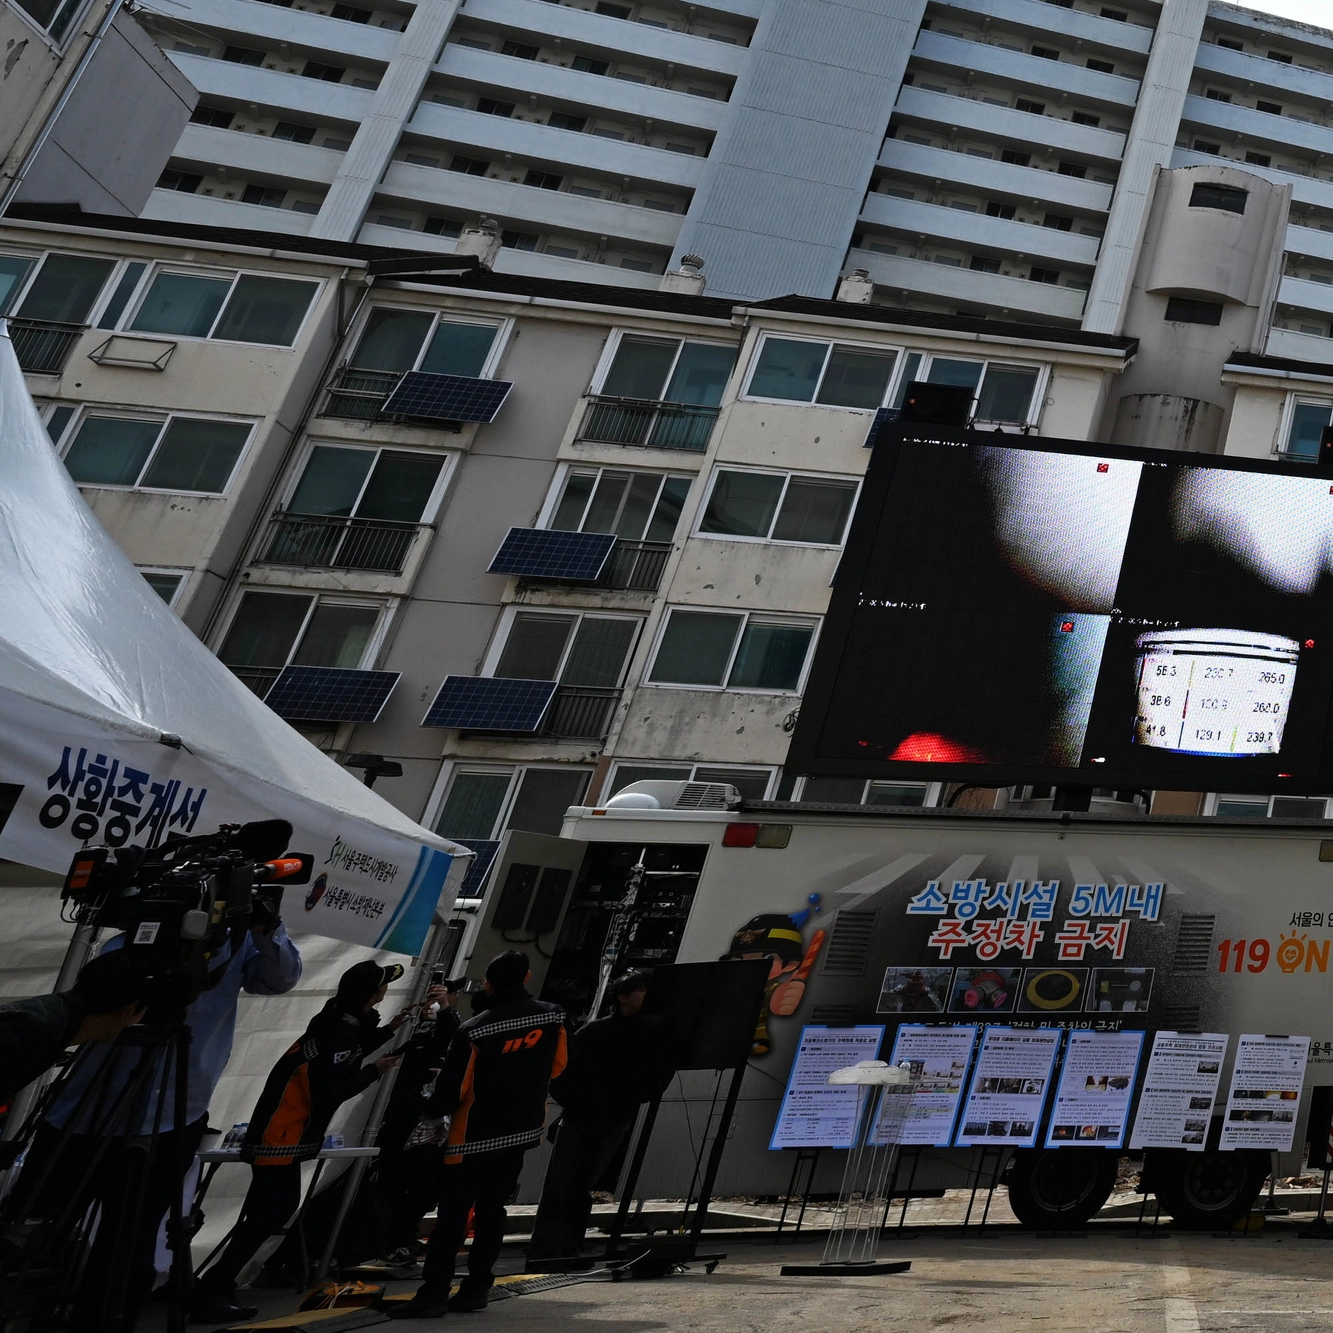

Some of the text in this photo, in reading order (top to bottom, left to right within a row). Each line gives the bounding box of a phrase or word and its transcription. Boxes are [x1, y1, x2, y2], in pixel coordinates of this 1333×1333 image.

[908, 880, 1164, 920] 소방시설 5M내
[1289, 912, 1324, 928] 서울의
[929, 919, 1129, 960] 주정차 금지
[1217, 939, 1270, 973] 119
[1276, 930, 1331, 973] ON
[501, 1029, 543, 1054] 119
